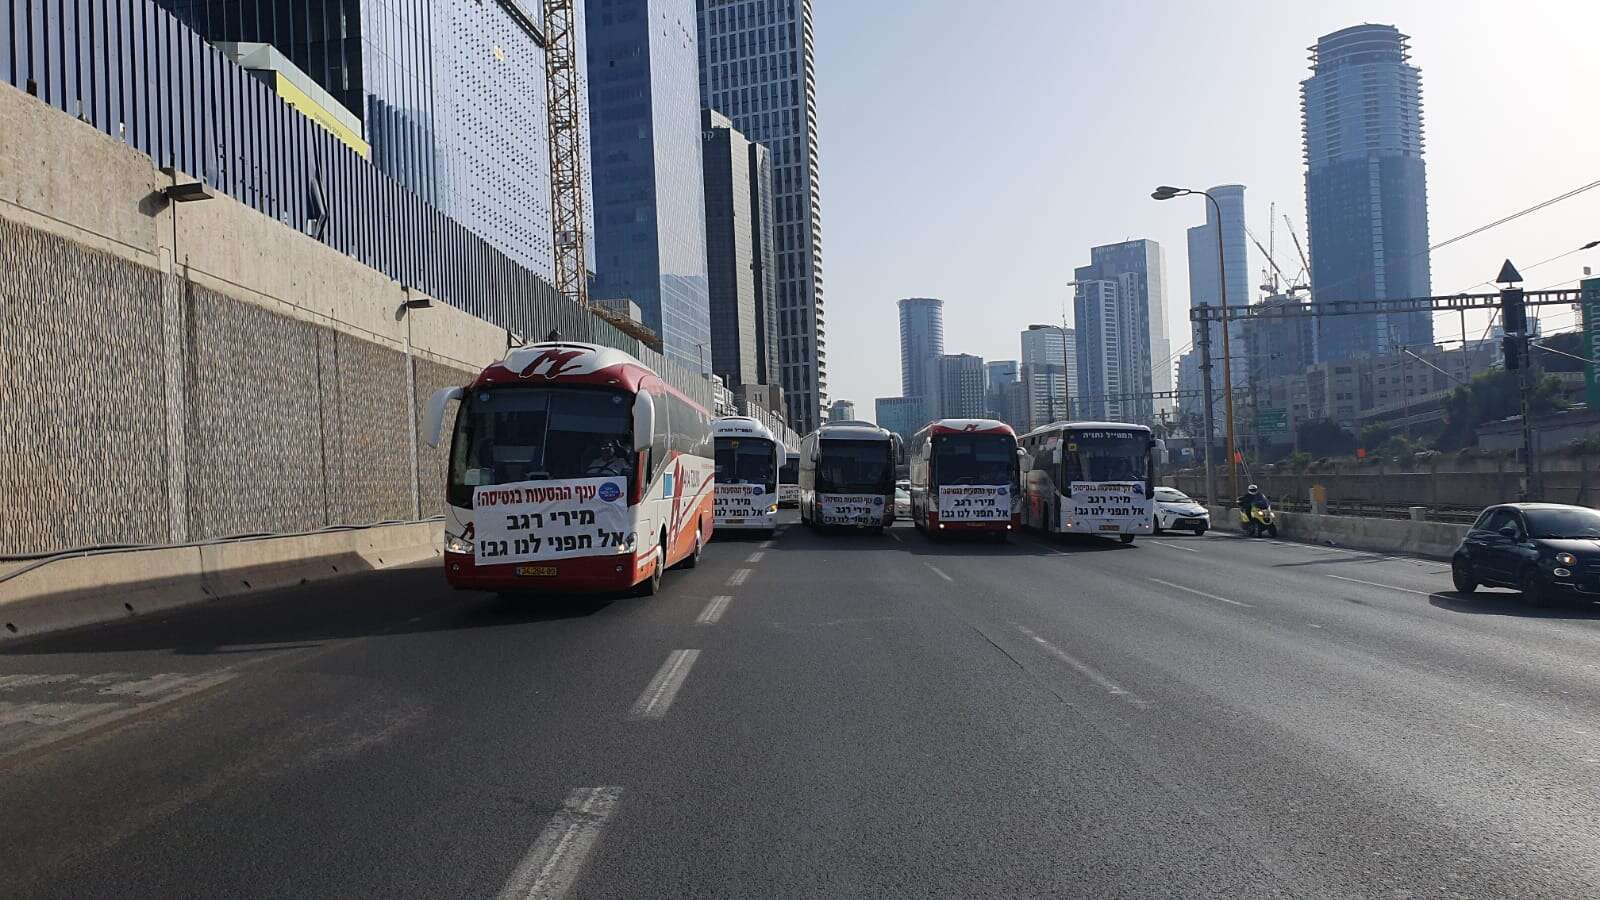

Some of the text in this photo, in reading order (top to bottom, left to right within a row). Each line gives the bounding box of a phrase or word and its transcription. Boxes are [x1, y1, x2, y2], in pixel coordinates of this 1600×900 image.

[477, 489, 522, 506] בגסיסה!
[525, 485, 572, 504] ההסעות
[575, 485, 596, 504] ענף
[715, 507, 727, 516] לנו
[751, 507, 763, 516] אל
[942, 510, 955, 518] גב!
[957, 508, 971, 517] לנו
[996, 508, 1008, 517] אל
[1075, 507, 1089, 515] גב!
[1091, 506, 1105, 515] לנו
[1131, 506, 1144, 515] אל
[507, 509, 595, 530] מירי רגב
[481, 528, 624, 557] אל תפני לנו גב!
